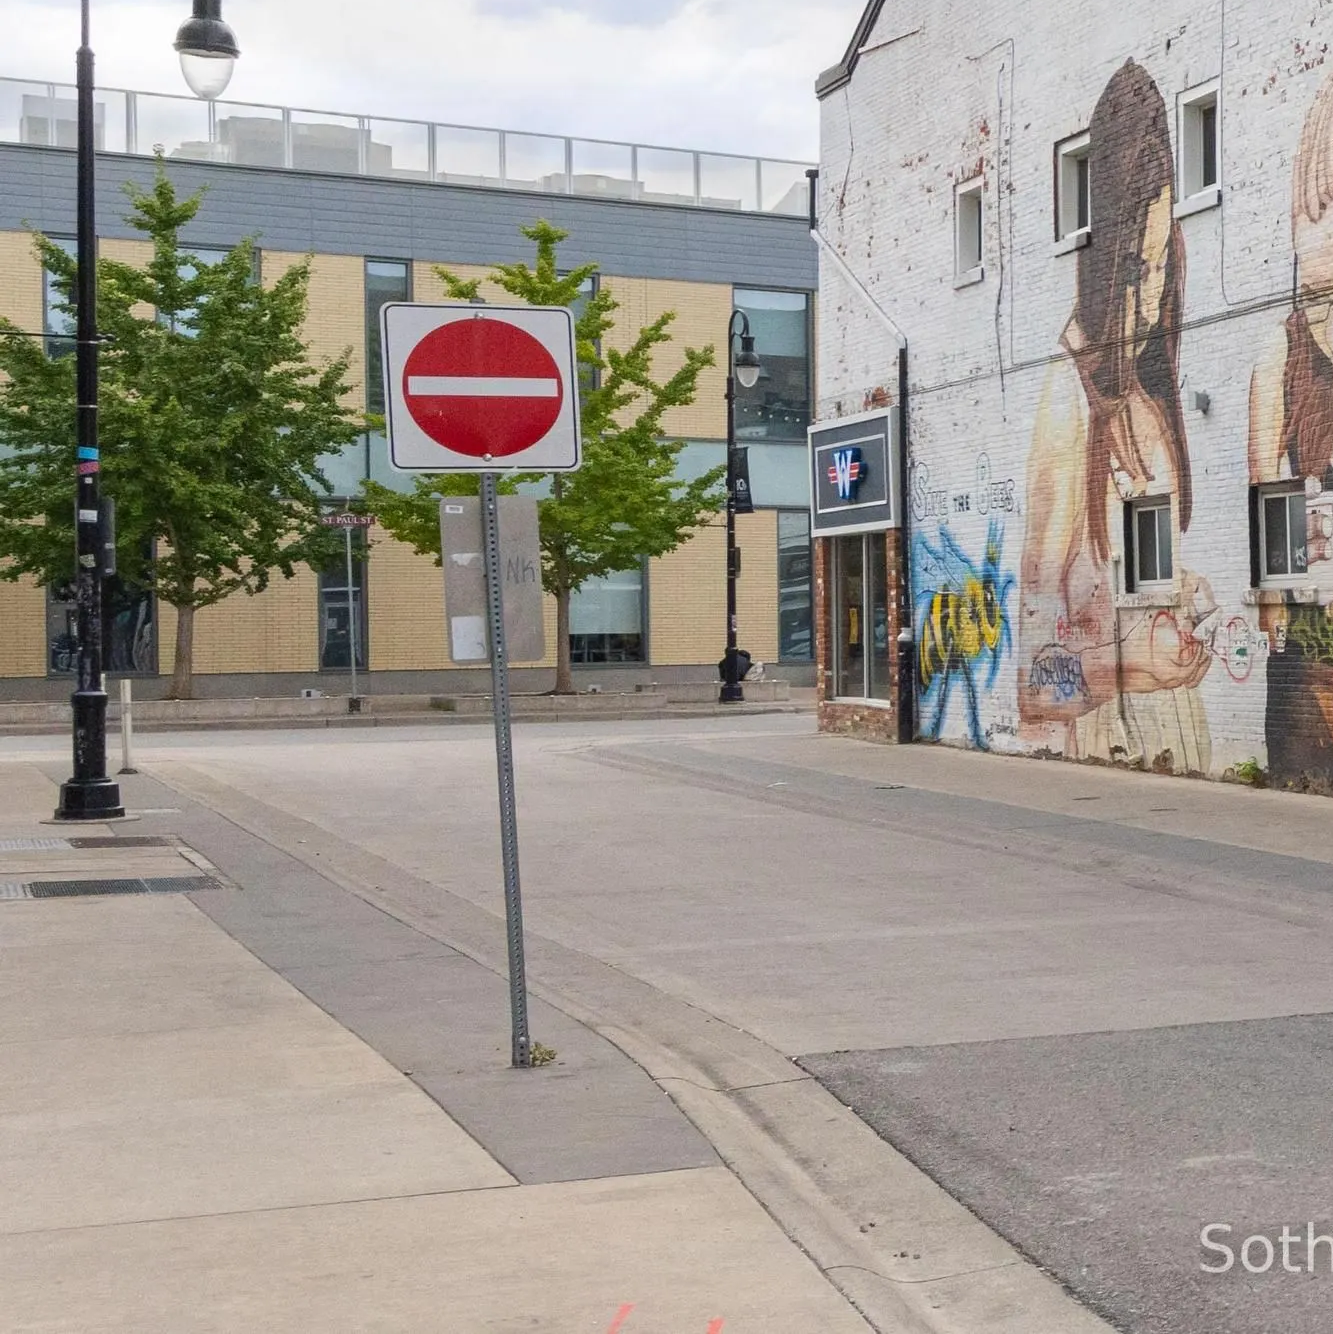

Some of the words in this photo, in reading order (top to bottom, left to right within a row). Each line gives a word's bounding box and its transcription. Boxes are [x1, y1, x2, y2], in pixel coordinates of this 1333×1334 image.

[911, 461, 949, 521] SAVE
[953, 495, 971, 513] THE
[336, 516, 359, 524] PAUL
